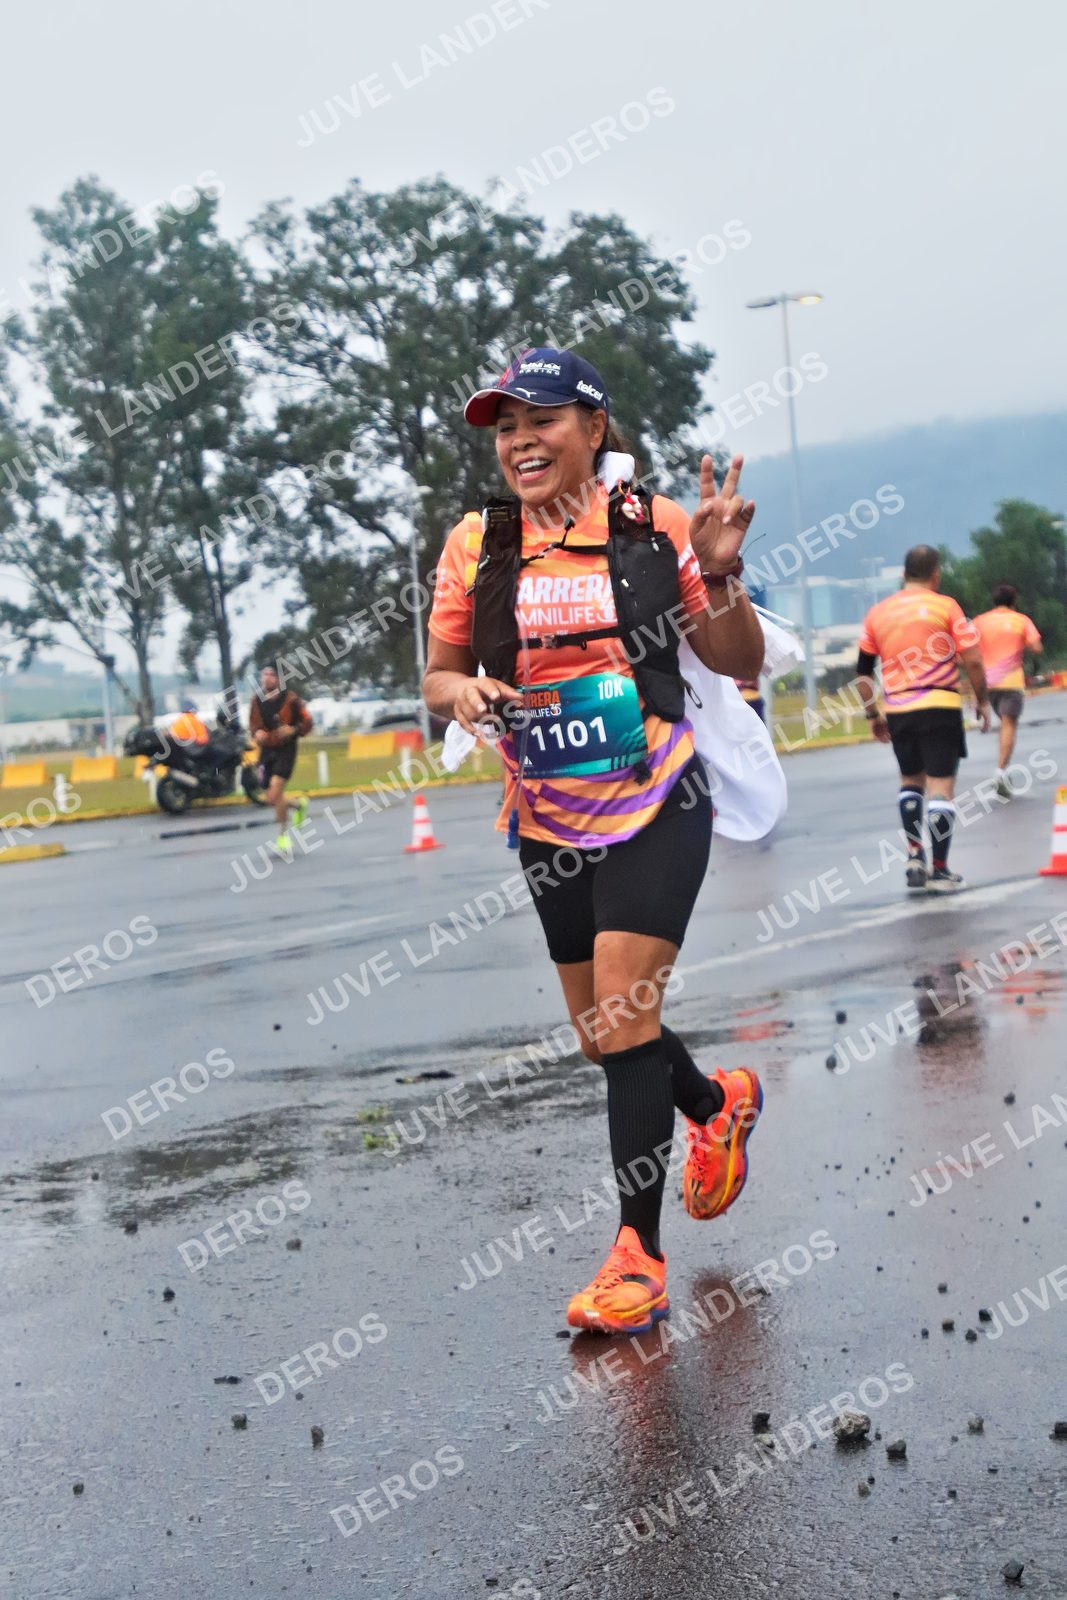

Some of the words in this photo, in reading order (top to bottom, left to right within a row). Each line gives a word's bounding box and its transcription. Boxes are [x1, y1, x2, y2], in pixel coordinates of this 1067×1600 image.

[576, 380, 603, 401] telcel
[597, 679, 624, 701] 10K
[531, 716, 607, 751] 1101
